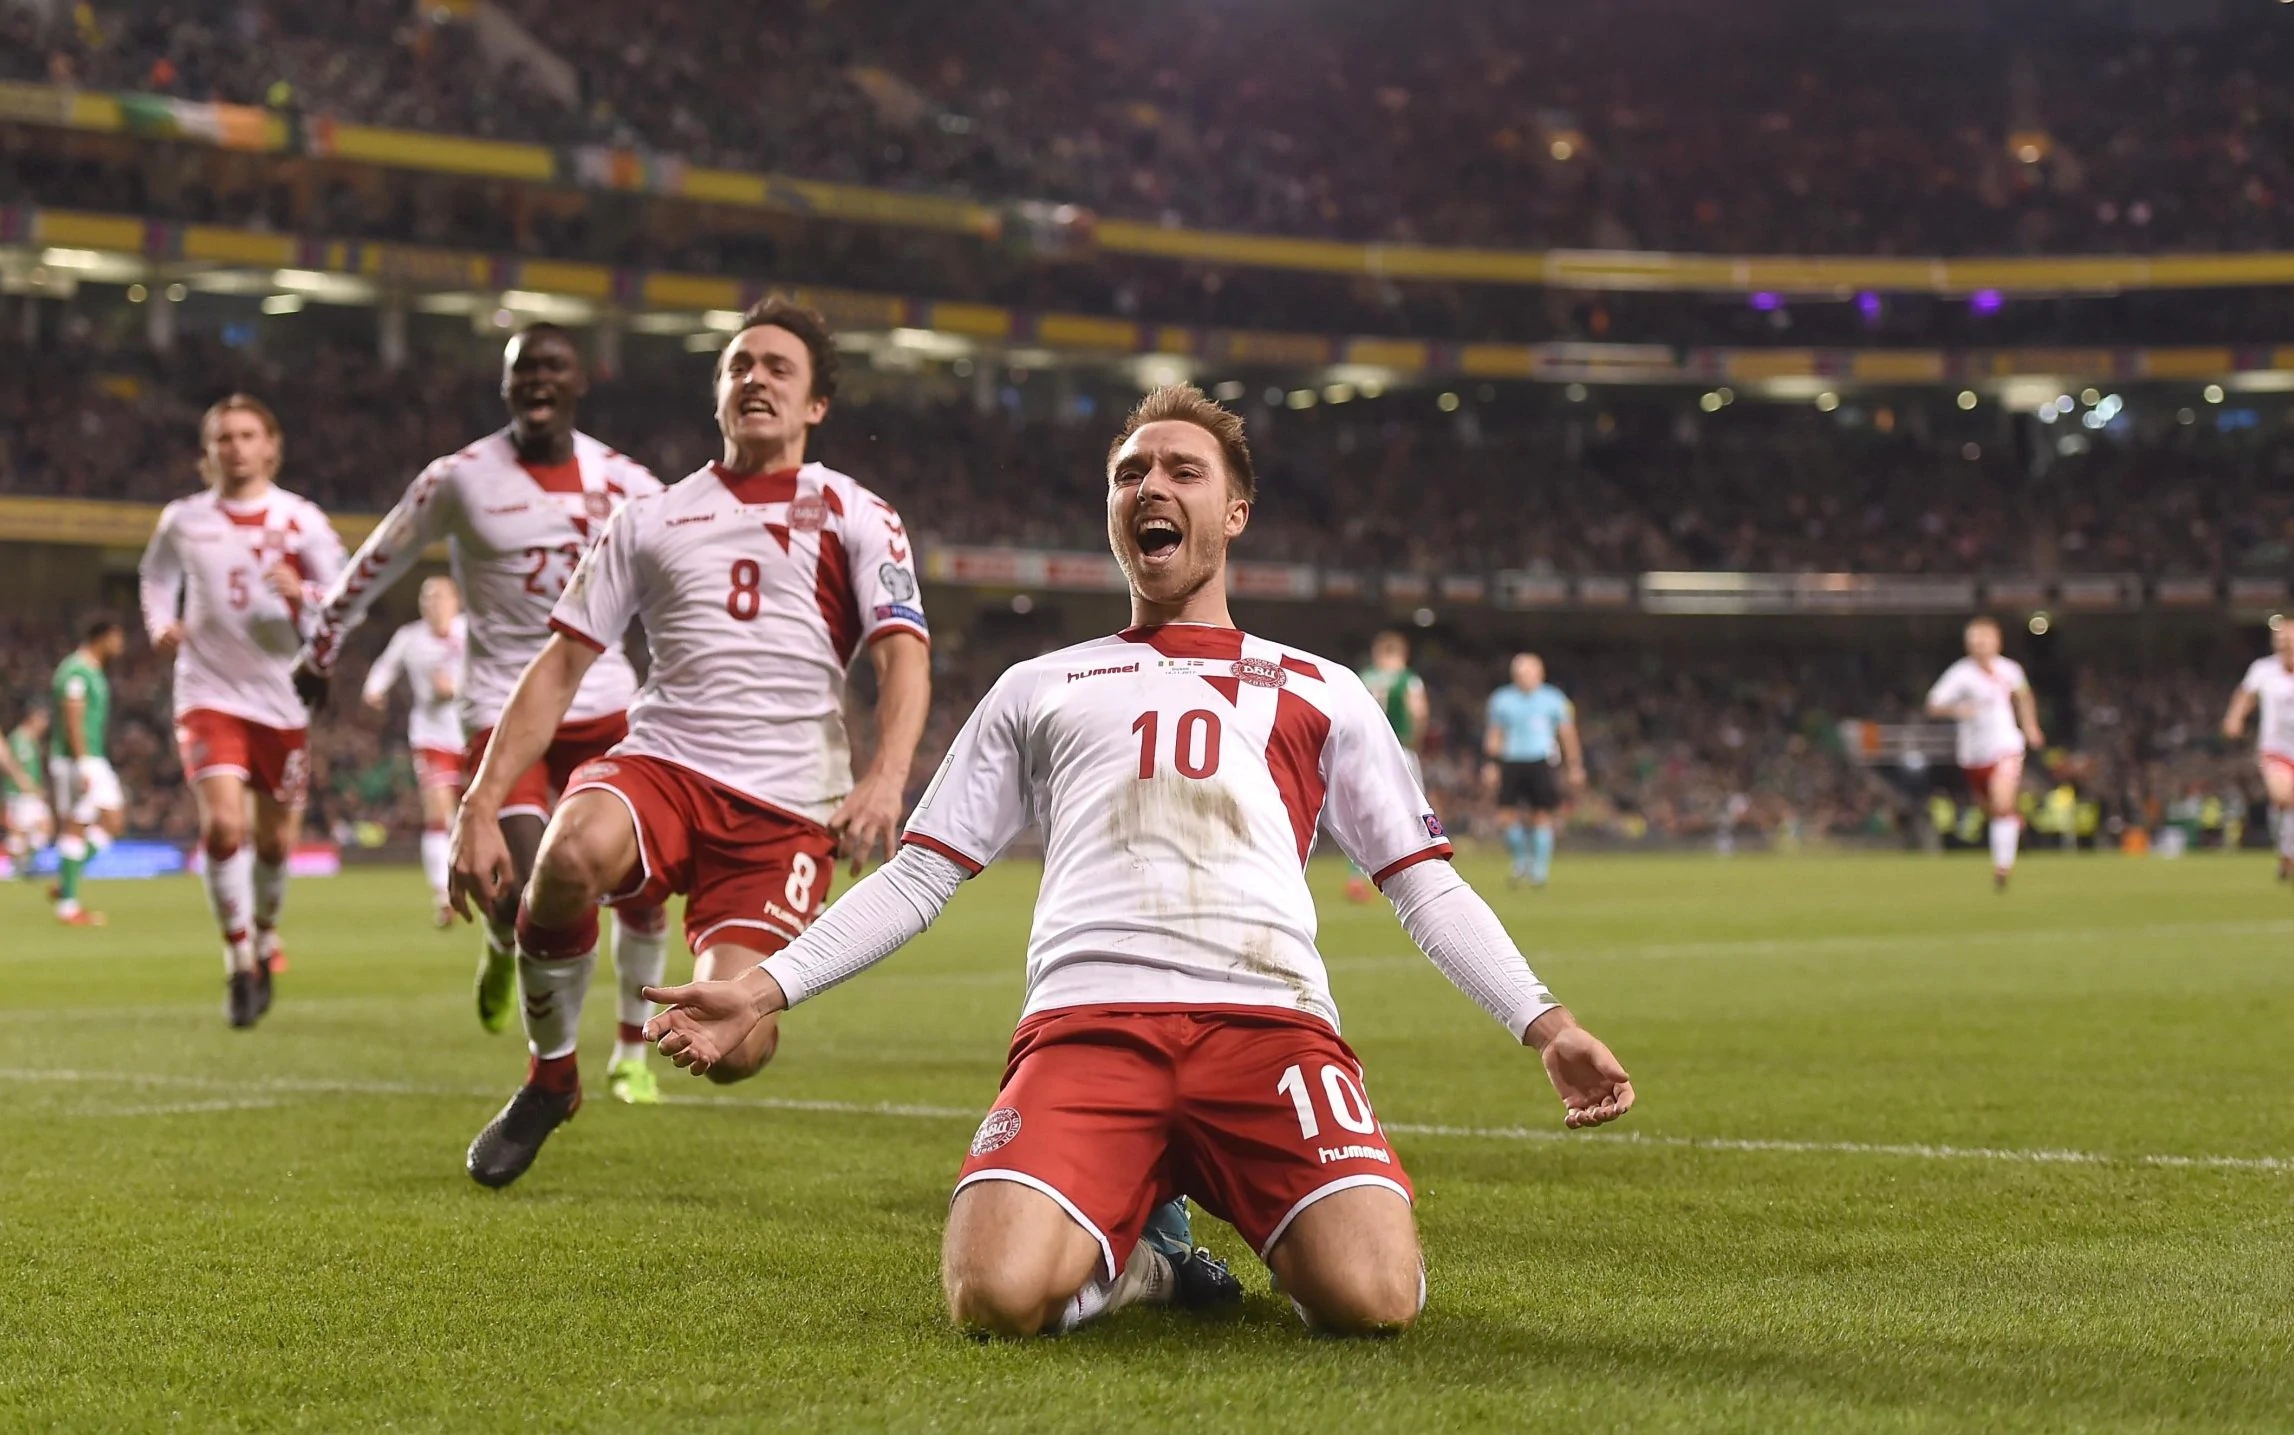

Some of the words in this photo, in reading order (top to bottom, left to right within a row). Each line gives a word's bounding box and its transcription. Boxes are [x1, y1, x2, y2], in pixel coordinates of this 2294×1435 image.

[227, 566, 250, 612] 5
[727, 558, 761, 621] 8
[1067, 662, 1140, 683] hummel
[1242, 665, 1277, 680] DBU
[1131, 708, 1222, 780] 10
[784, 851, 817, 914] 8
[1277, 1064, 1375, 1140] 10
[1318, 1145, 1391, 1165] hummel
